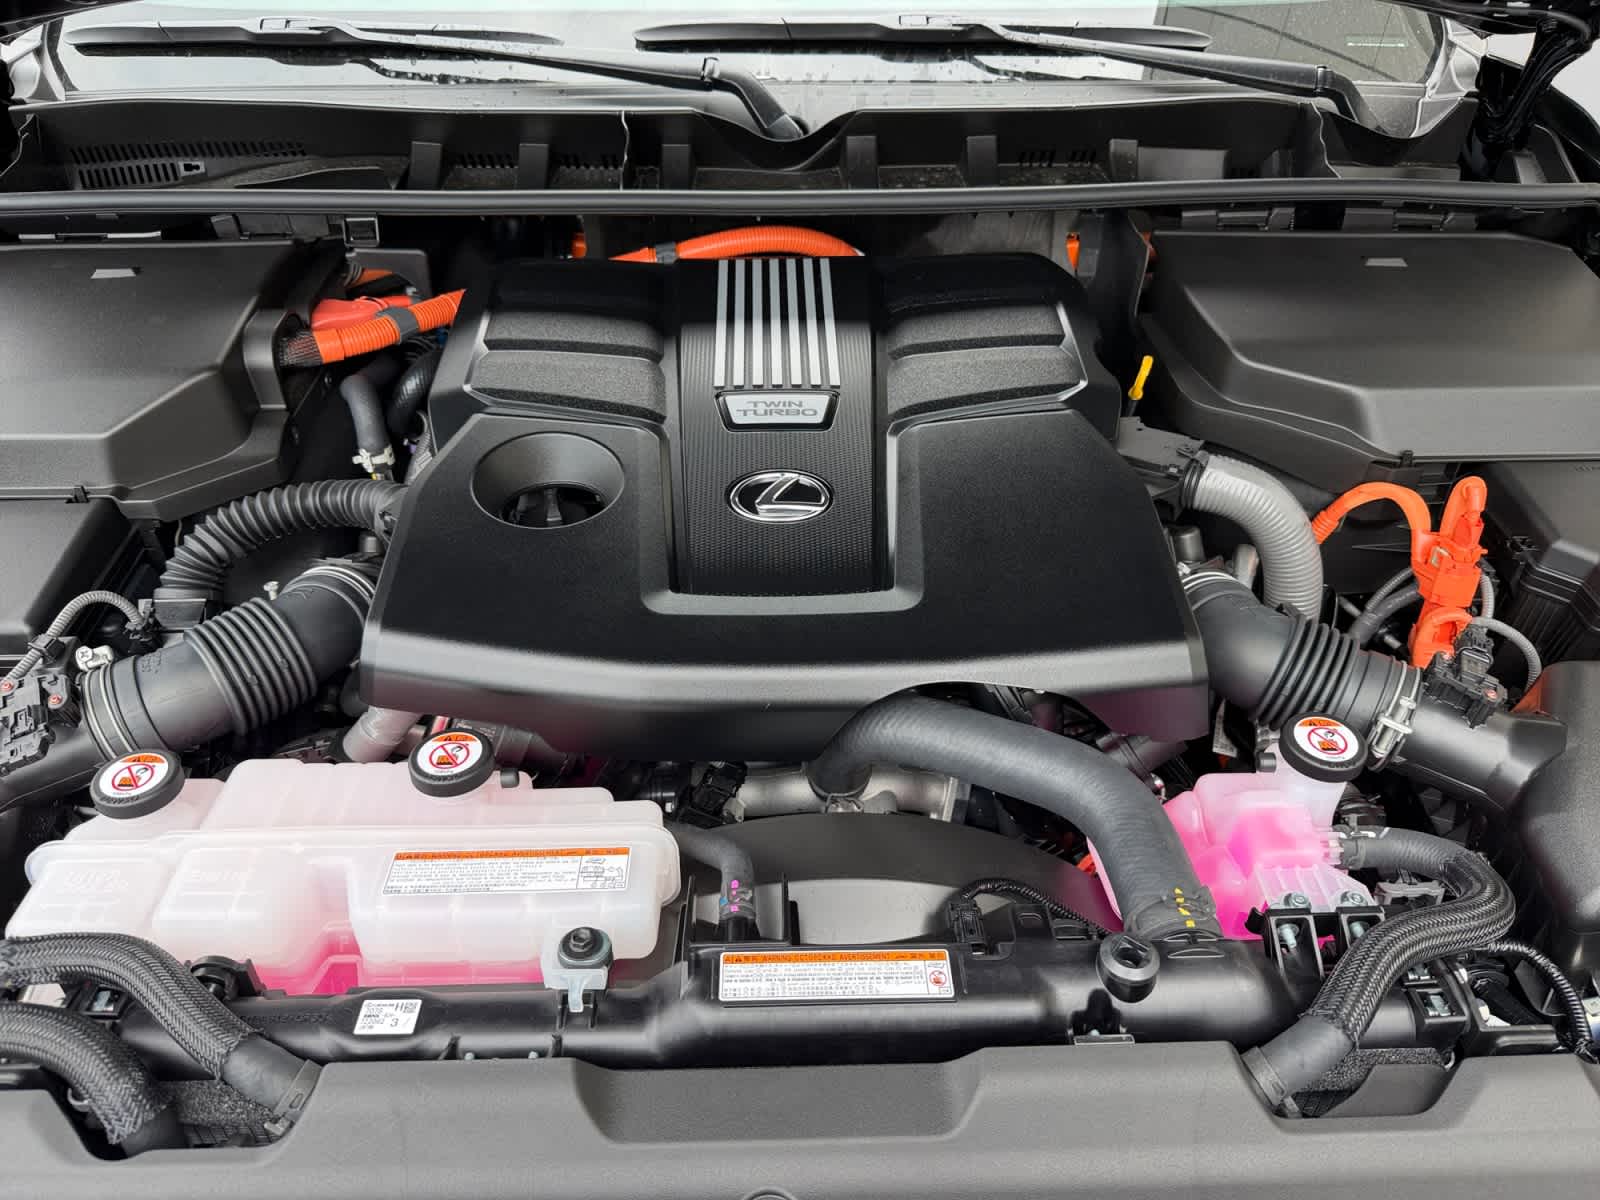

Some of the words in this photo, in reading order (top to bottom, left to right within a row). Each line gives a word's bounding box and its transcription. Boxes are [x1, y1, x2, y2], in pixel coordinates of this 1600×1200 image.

[746, 400, 803, 408] TWIN
[736, 408, 818, 417] TURBO
[390, 1018, 399, 1028] 3
